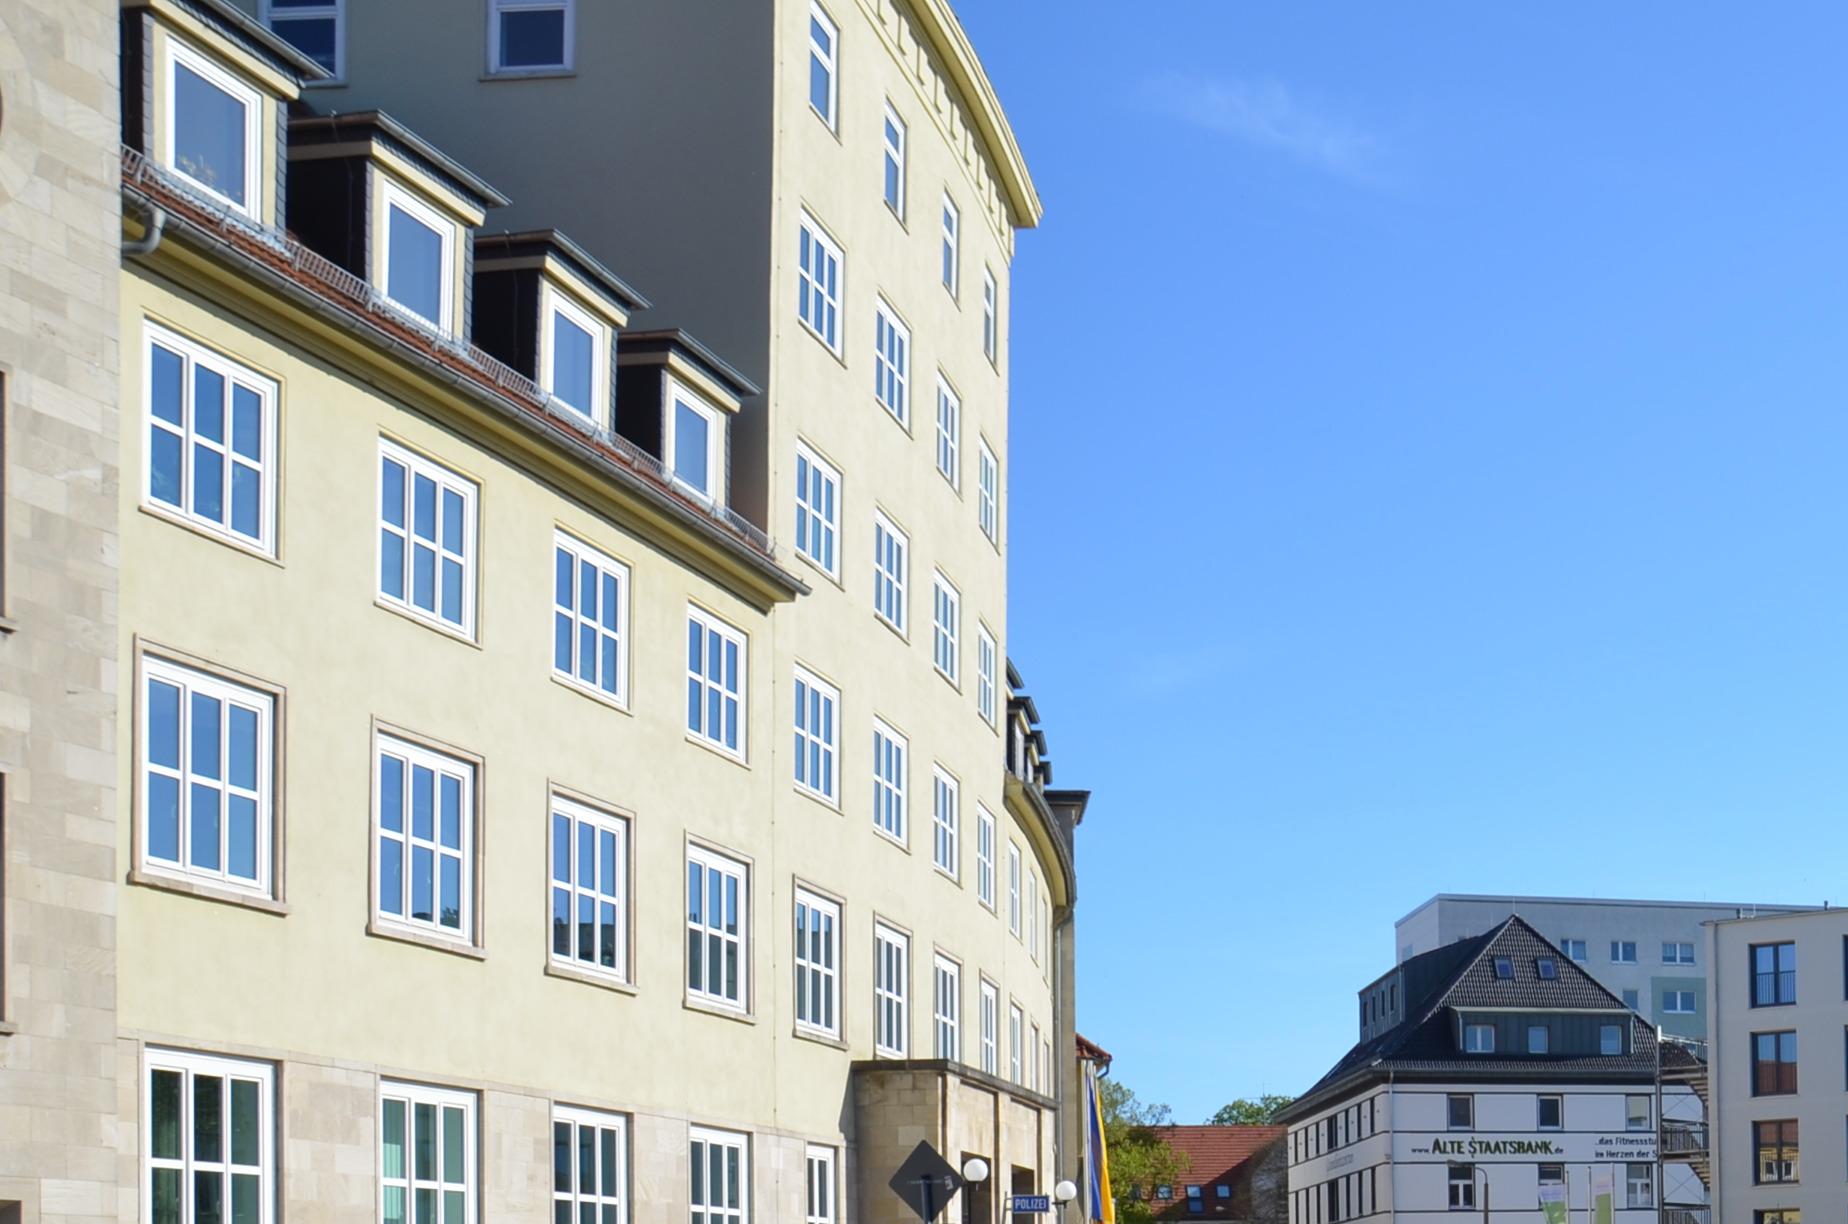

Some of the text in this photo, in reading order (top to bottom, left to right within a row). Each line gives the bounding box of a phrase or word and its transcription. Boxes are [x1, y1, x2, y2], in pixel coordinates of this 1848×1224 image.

[1615, 1136, 1656, 1145] Fitnessstu
[1432, 1138, 1465, 1154] ALTE
[1606, 1150, 1634, 1158] Herzen
[1636, 1150, 1650, 1158] der
[1014, 1198, 1047, 1210] POLIZEI
